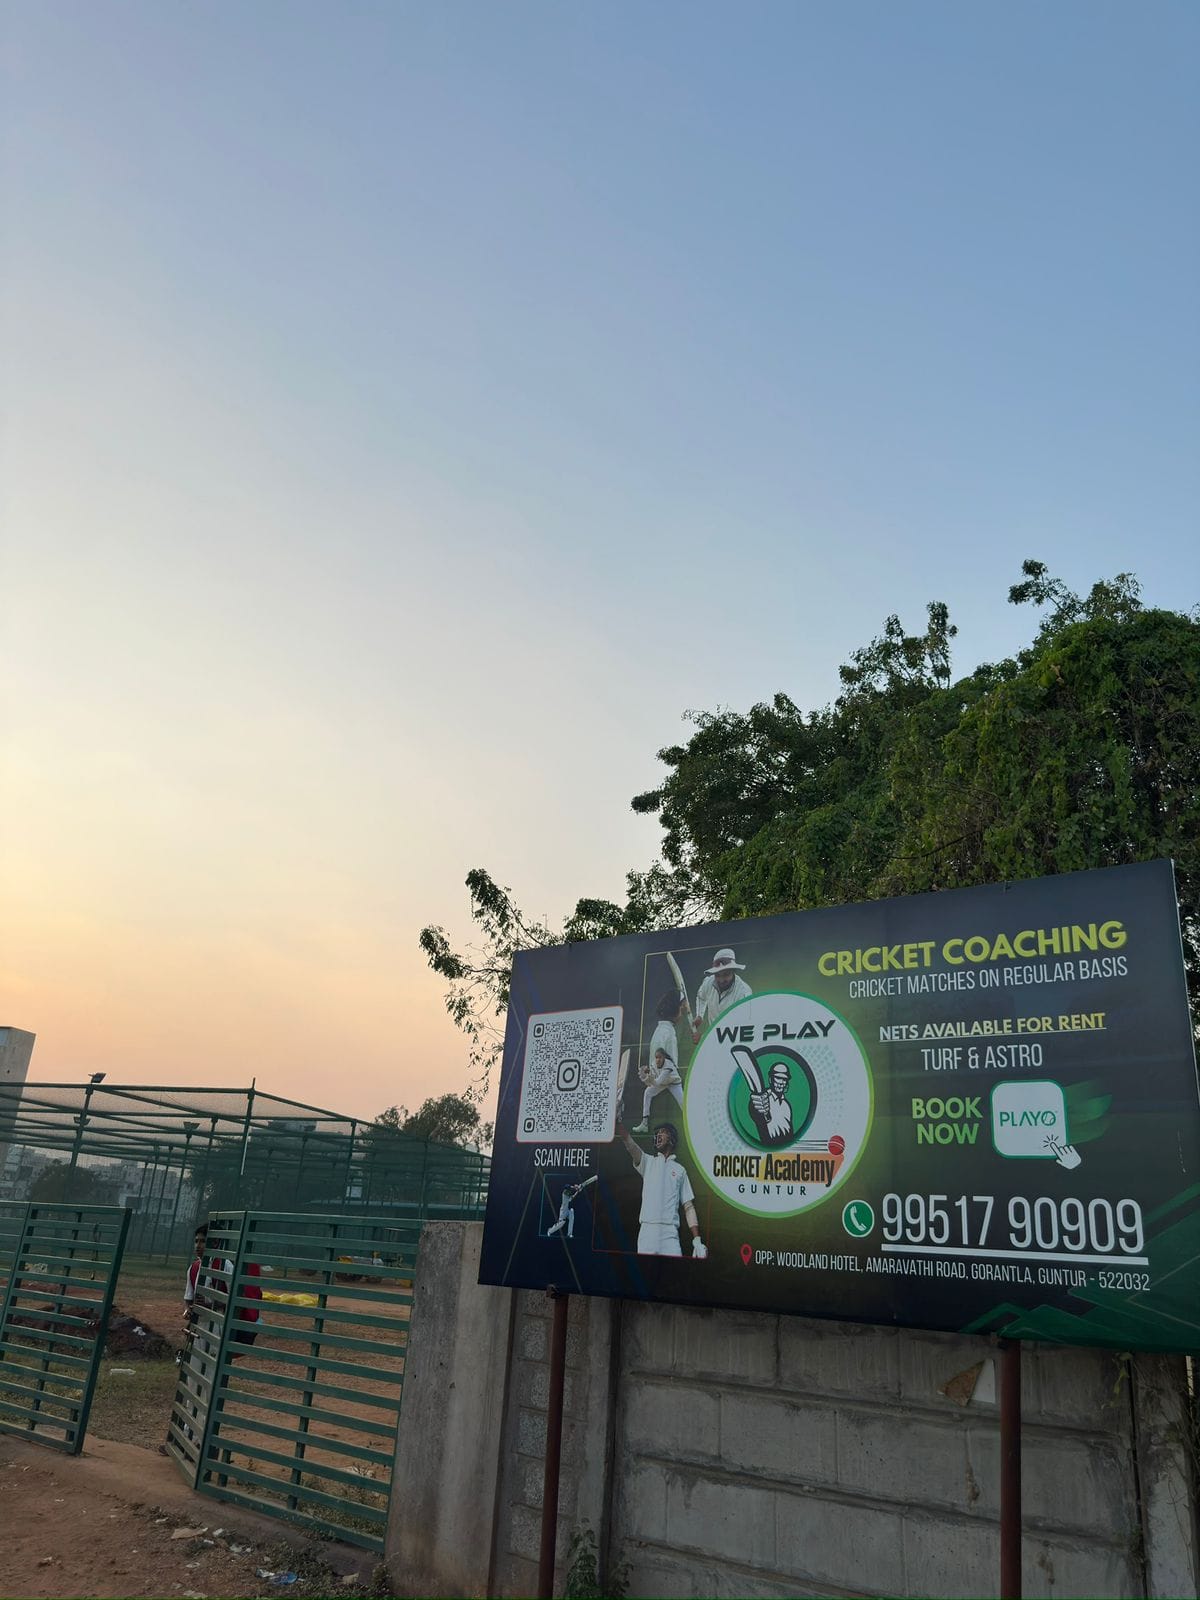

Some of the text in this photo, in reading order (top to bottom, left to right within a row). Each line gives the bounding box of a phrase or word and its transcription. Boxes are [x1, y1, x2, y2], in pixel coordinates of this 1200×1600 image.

[818, 921, 1127, 976] CRICKET COACHING
[849, 955, 1129, 999] CRICKET MATCHES ON REGULAR BASIS
[716, 1019, 836, 1043] WE PLAY
[879, 1012, 1106, 1041] NETS AVAILABLE FOR RENT
[921, 1043, 1043, 1070] TURF & ASTRO
[911, 1096, 983, 1120] BOOK
[999, 1110, 1057, 1127] PLAYO
[917, 1123, 979, 1145] NOW
[534, 1149, 590, 1167] SCAN HERE
[713, 1154, 836, 1187] CRICKET Academy
[738, 1184, 807, 1196] GUNTUR
[882, 1193, 1144, 1253] 99517 90909
[776, 1252, 828, 1270] WOODLAND
[830, 1255, 863, 1273] HOTEL,
[865, 1258, 934, 1276] AMARAVATHI
[1038, 1269, 1087, 1287] GUNTUR
[1099, 1271, 1151, 1291] 522032
